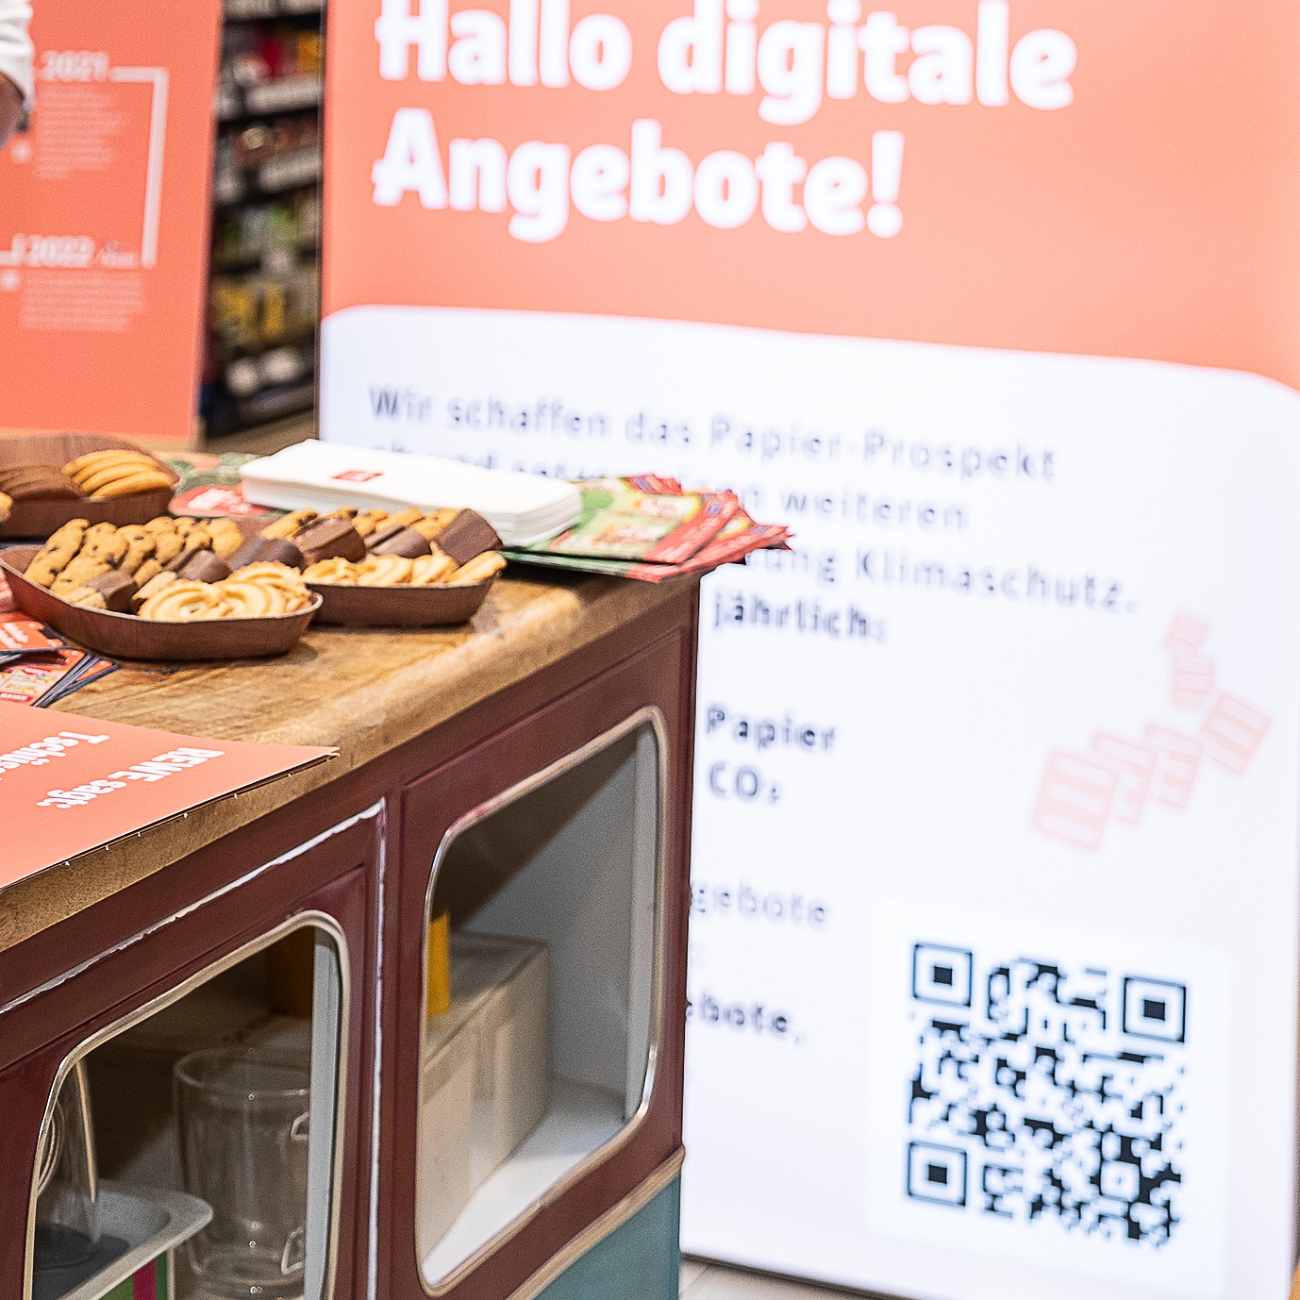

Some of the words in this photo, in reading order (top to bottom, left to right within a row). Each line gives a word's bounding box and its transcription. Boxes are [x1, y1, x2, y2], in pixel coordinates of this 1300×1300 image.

[372, 107, 906, 243] Angebote!
[369, 384, 432, 422] Wir
[447, 395, 606, 434] schaffen
[624, 411, 694, 444] das
[782, 484, 968, 531] weiteren
[856, 548, 1137, 614] Klimaschutz.
[707, 704, 835, 751] Papier
[107, 747, 225, 783] REWE
[35, 779, 128, 809] sagt:
